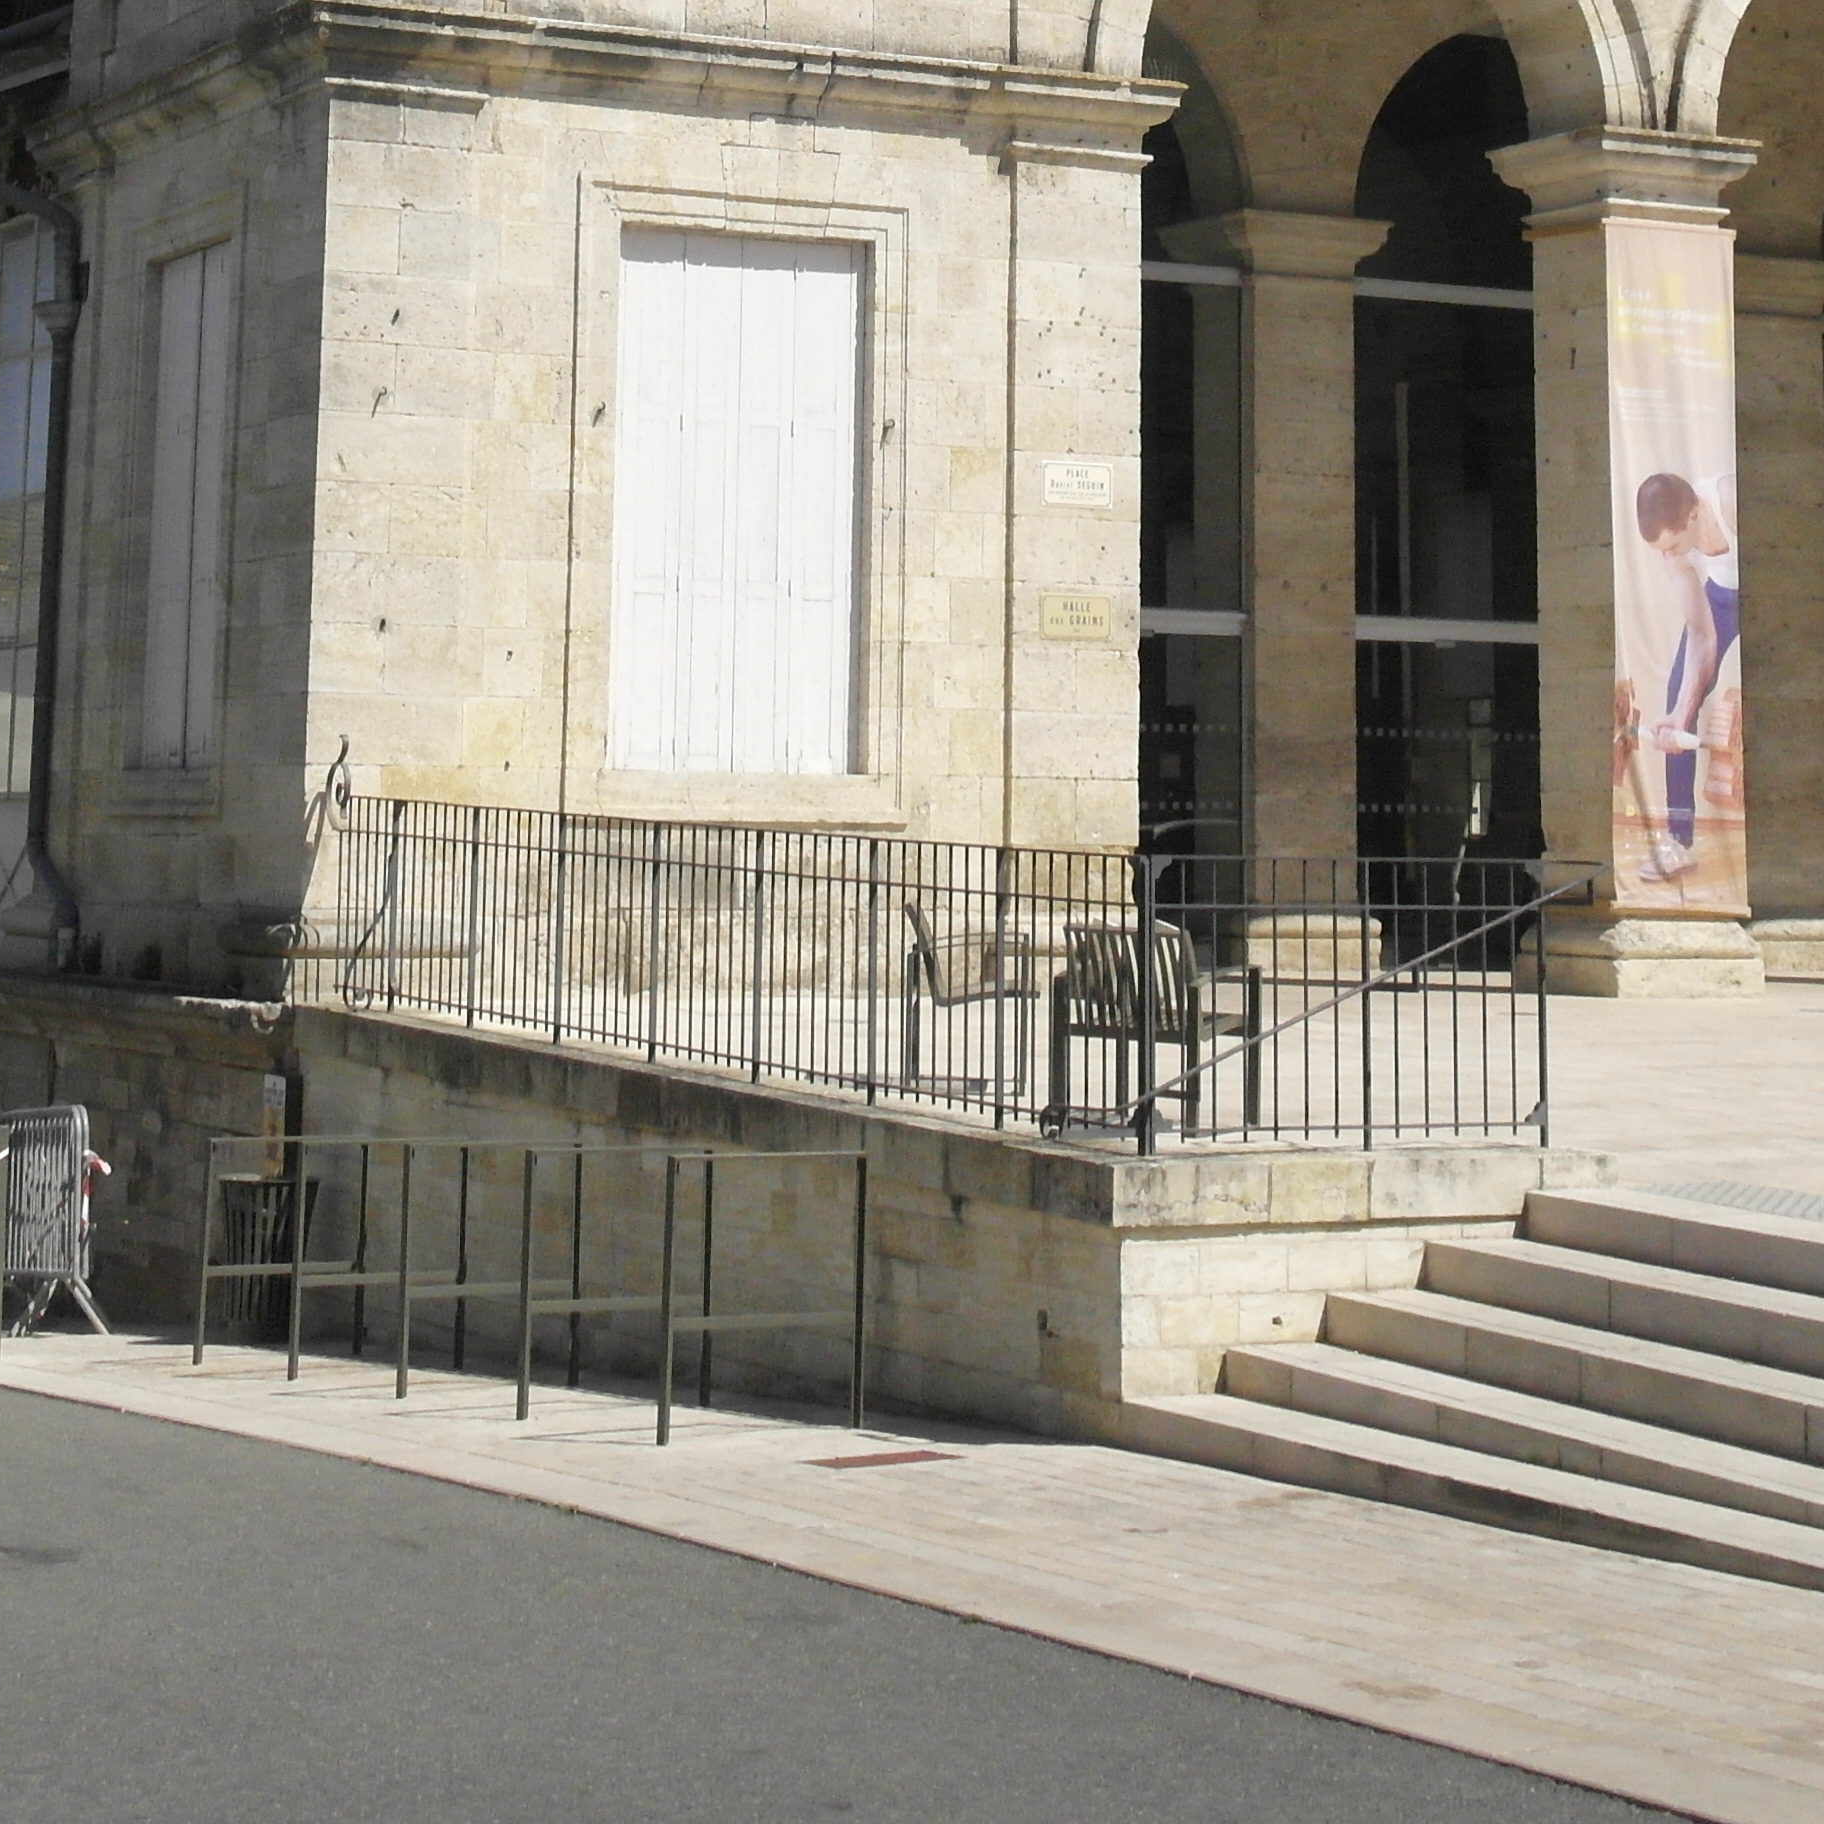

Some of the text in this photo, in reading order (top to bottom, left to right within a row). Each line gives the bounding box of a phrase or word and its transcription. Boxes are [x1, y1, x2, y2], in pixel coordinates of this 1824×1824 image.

[1066, 469, 1088, 479] PLACE
[1062, 601, 1091, 613] HALLE
[1069, 614, 1104, 626] GRAINS
